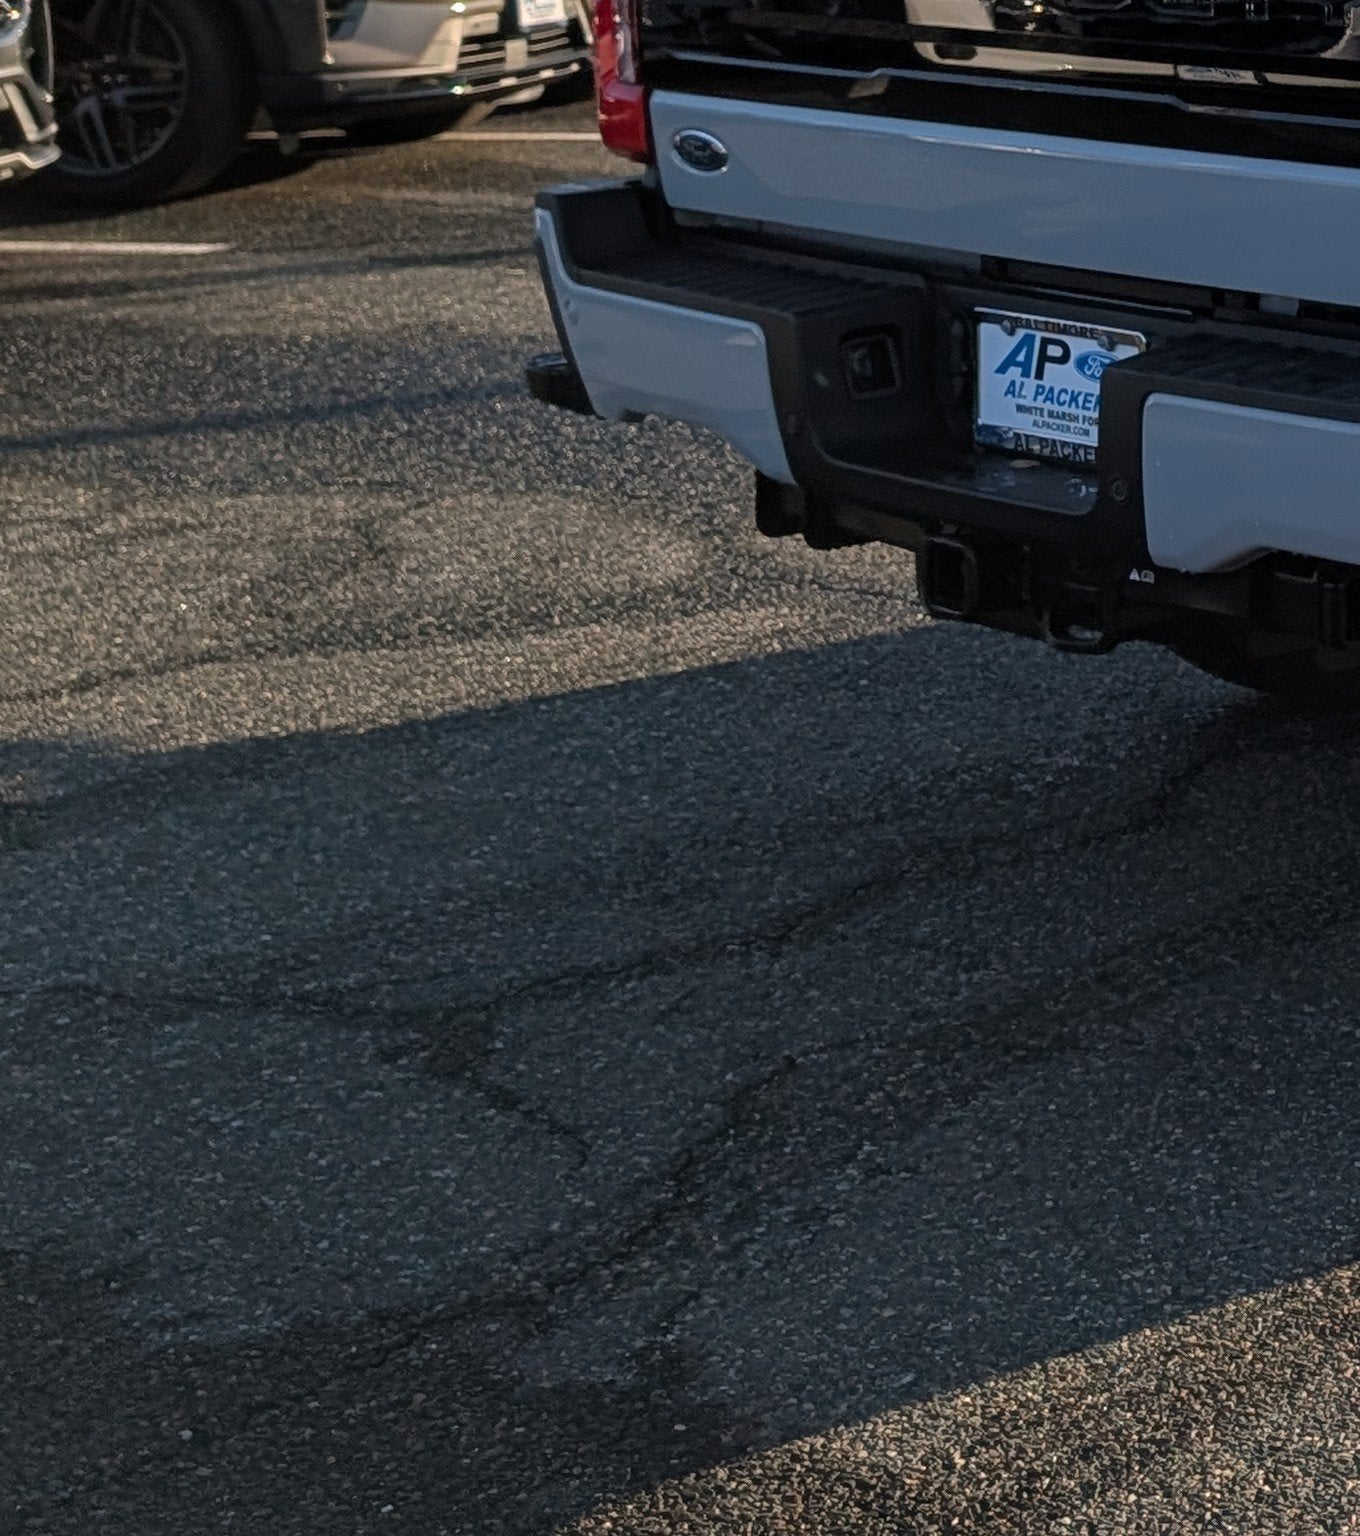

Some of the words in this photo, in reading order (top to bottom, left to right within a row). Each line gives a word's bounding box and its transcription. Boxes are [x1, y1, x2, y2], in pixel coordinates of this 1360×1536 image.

[994, 333, 1071, 381] AP
[1004, 379, 1027, 400] AL
[1039, 436, 1096, 462] PACKE
